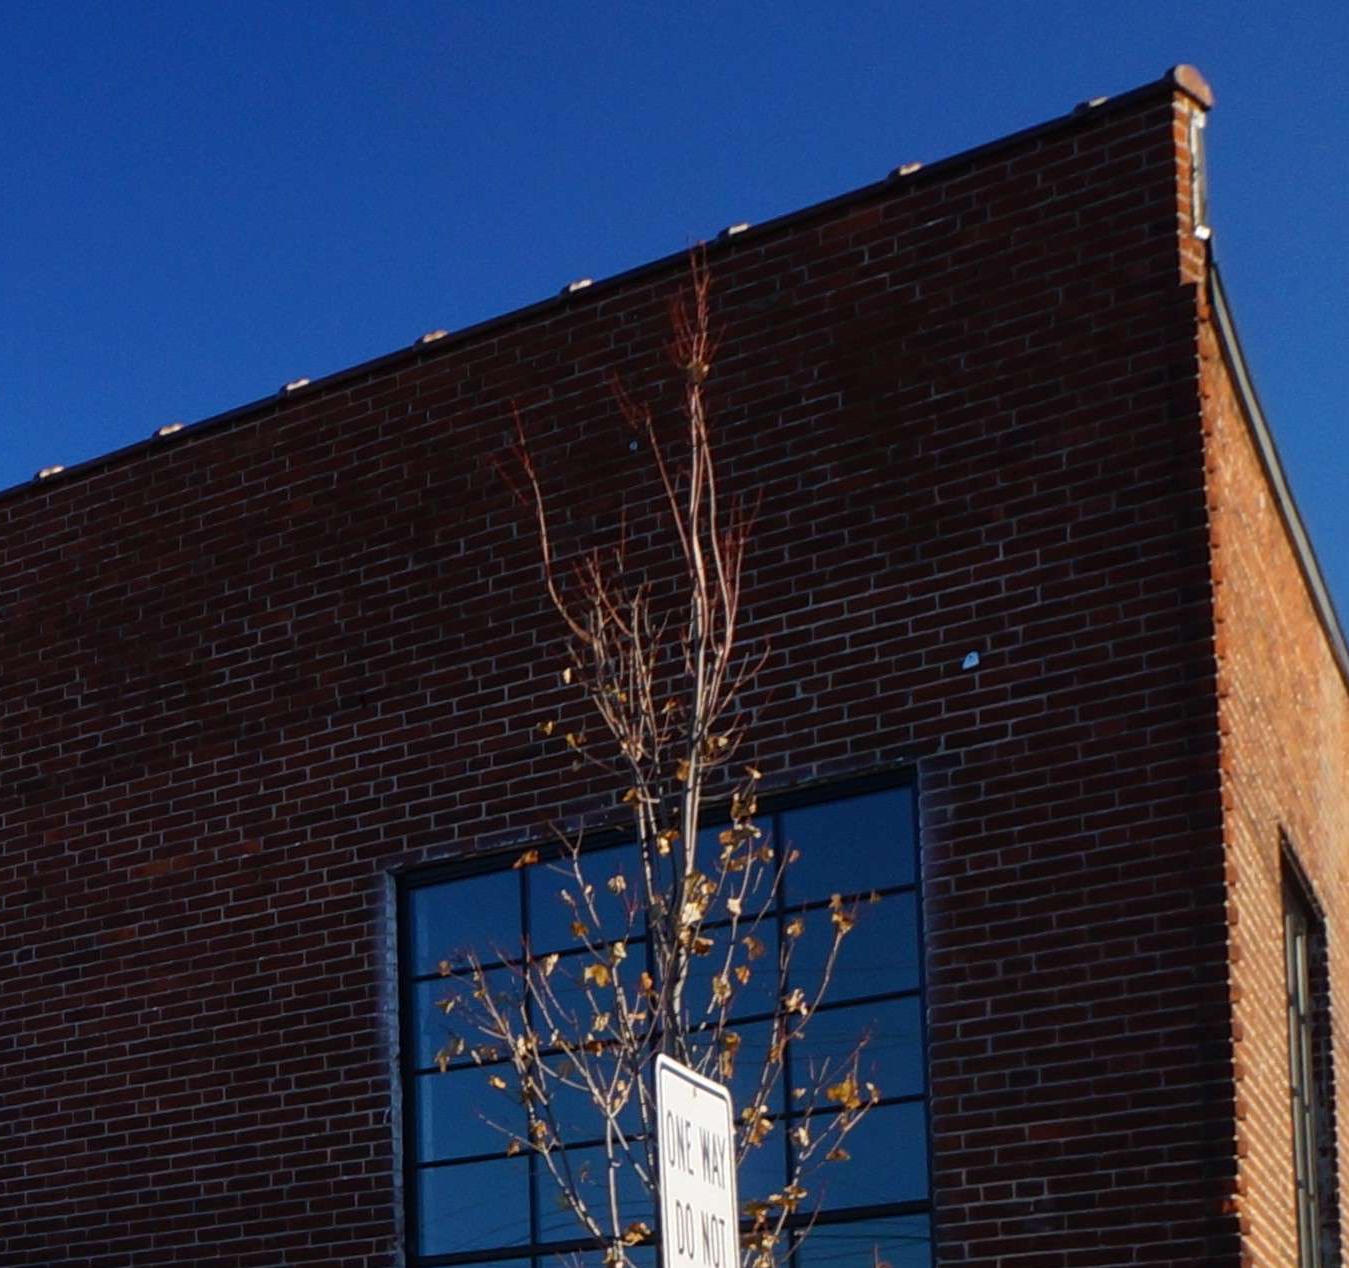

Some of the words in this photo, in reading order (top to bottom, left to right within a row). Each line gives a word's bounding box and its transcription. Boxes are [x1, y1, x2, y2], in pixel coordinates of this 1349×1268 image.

[666, 1110, 694, 1175] ONE
[699, 1127, 726, 1190] WAY
[675, 1199, 695, 1260] DO
